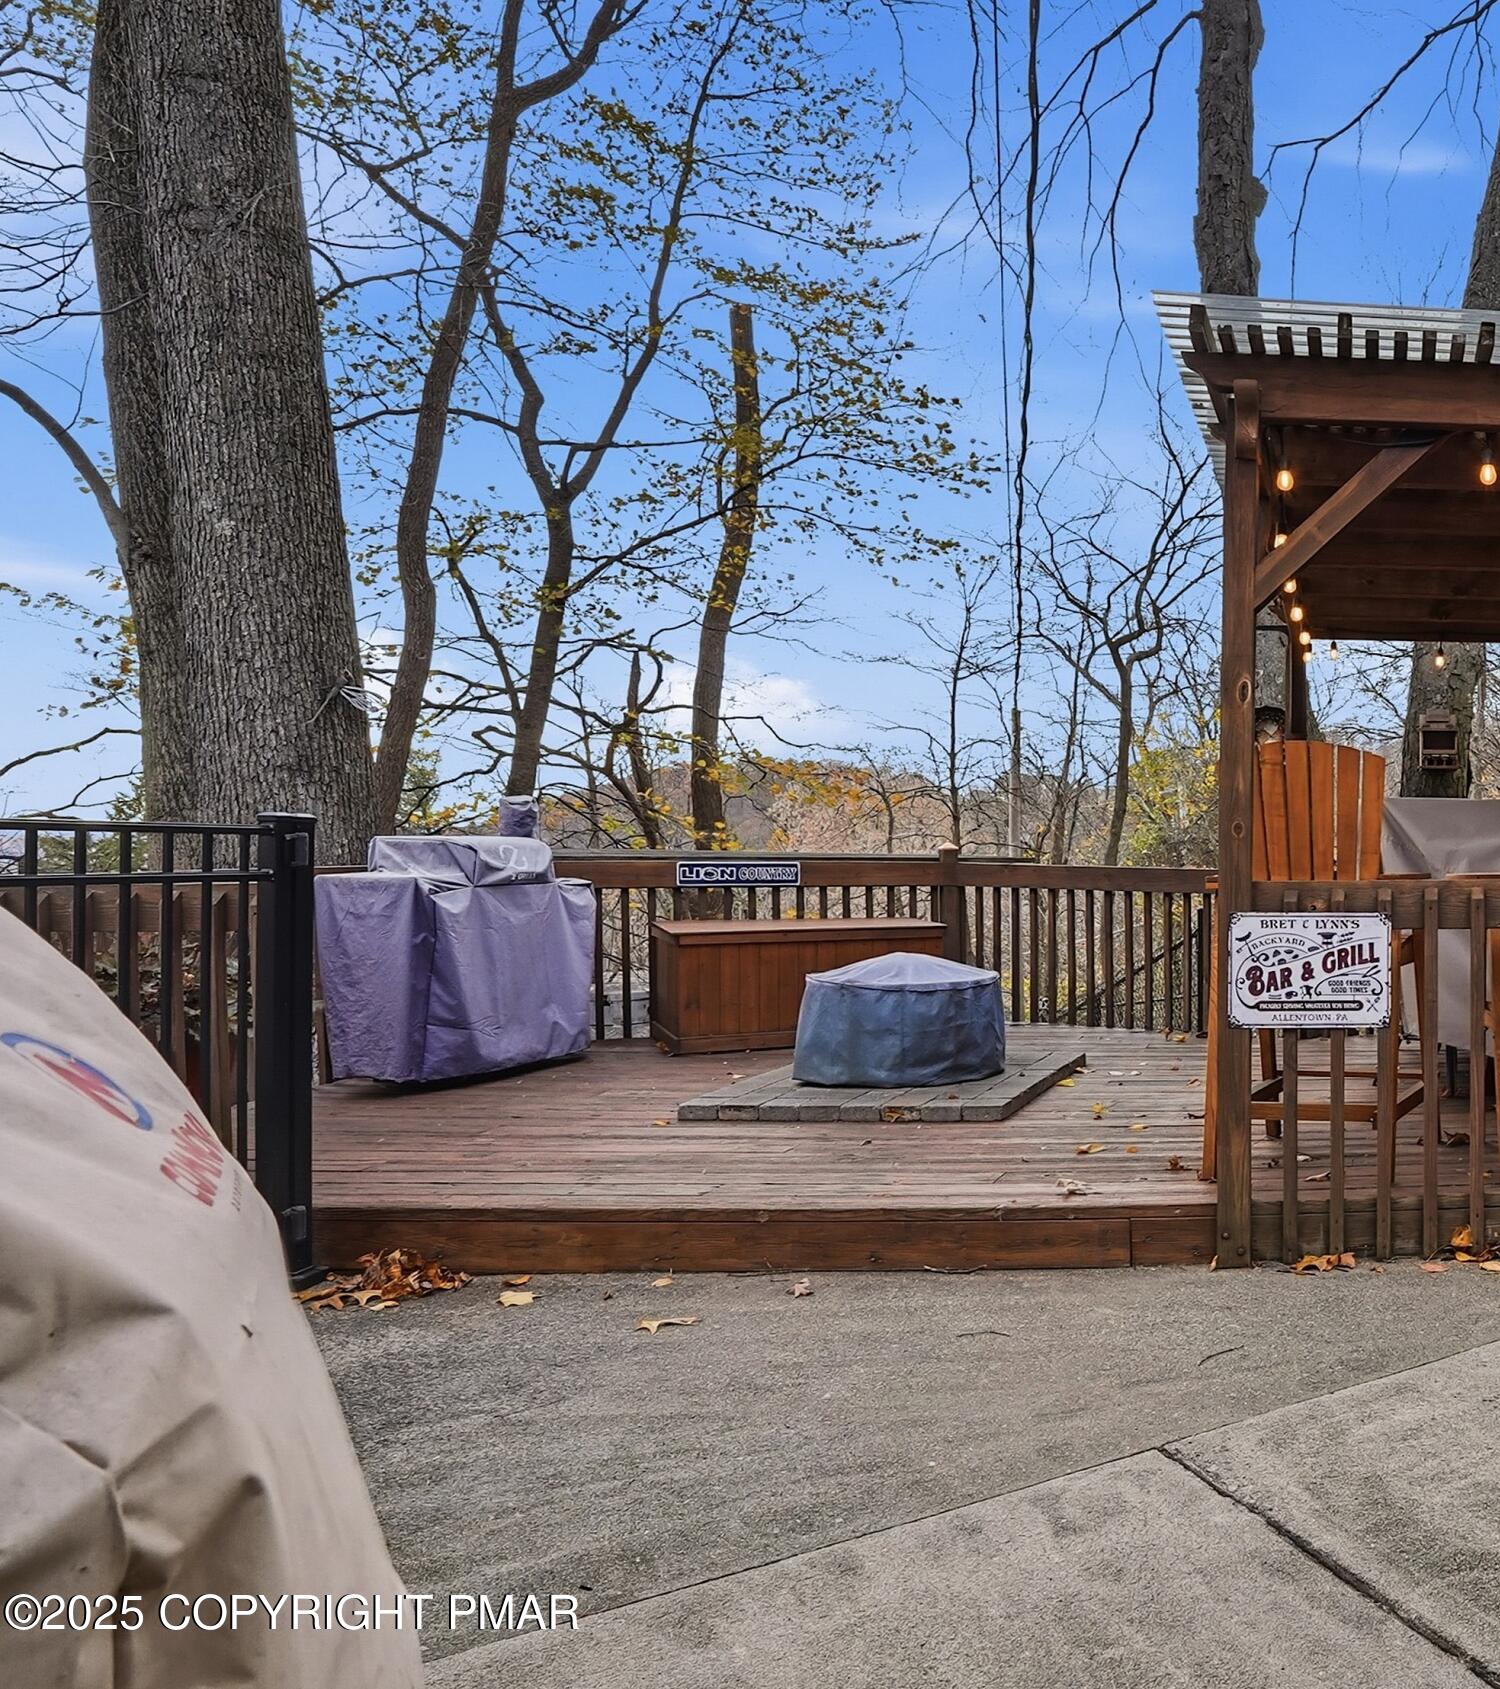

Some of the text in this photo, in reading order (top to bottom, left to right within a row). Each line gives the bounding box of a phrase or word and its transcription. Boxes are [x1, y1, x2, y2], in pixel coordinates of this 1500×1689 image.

[680, 866, 797, 880] LION COUNTRY
[1260, 919, 1296, 929] BRET
[1251, 936, 1306, 950] BACKYARD
[1245, 942, 1380, 997] BAR & GRILL
